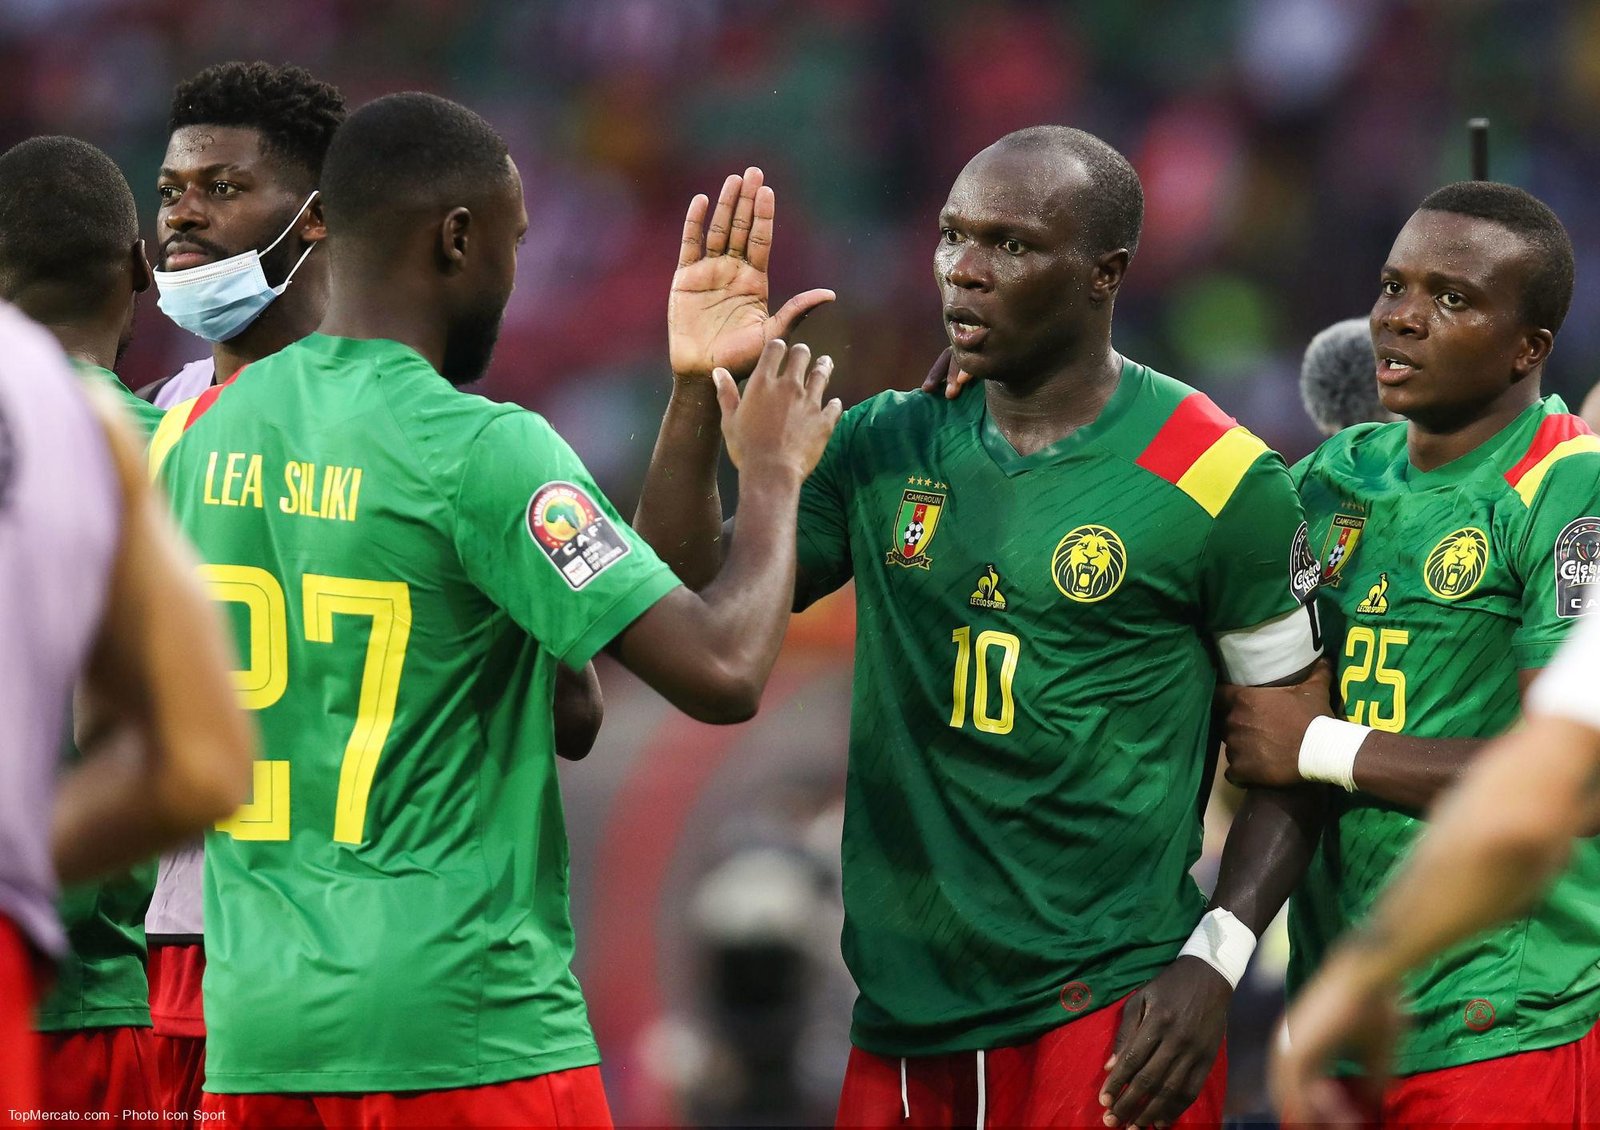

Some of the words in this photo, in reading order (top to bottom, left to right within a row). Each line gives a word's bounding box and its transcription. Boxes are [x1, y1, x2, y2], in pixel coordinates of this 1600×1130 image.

[204, 451, 263, 508] LEA
[279, 460, 362, 521] SILIKI
[906, 492, 942, 504] CAMEROUN
[1335, 517, 1363, 528] CAMEROUN
[195, 563, 412, 845] 27
[949, 625, 1020, 735] 10
[1340, 626, 1409, 734] 25
